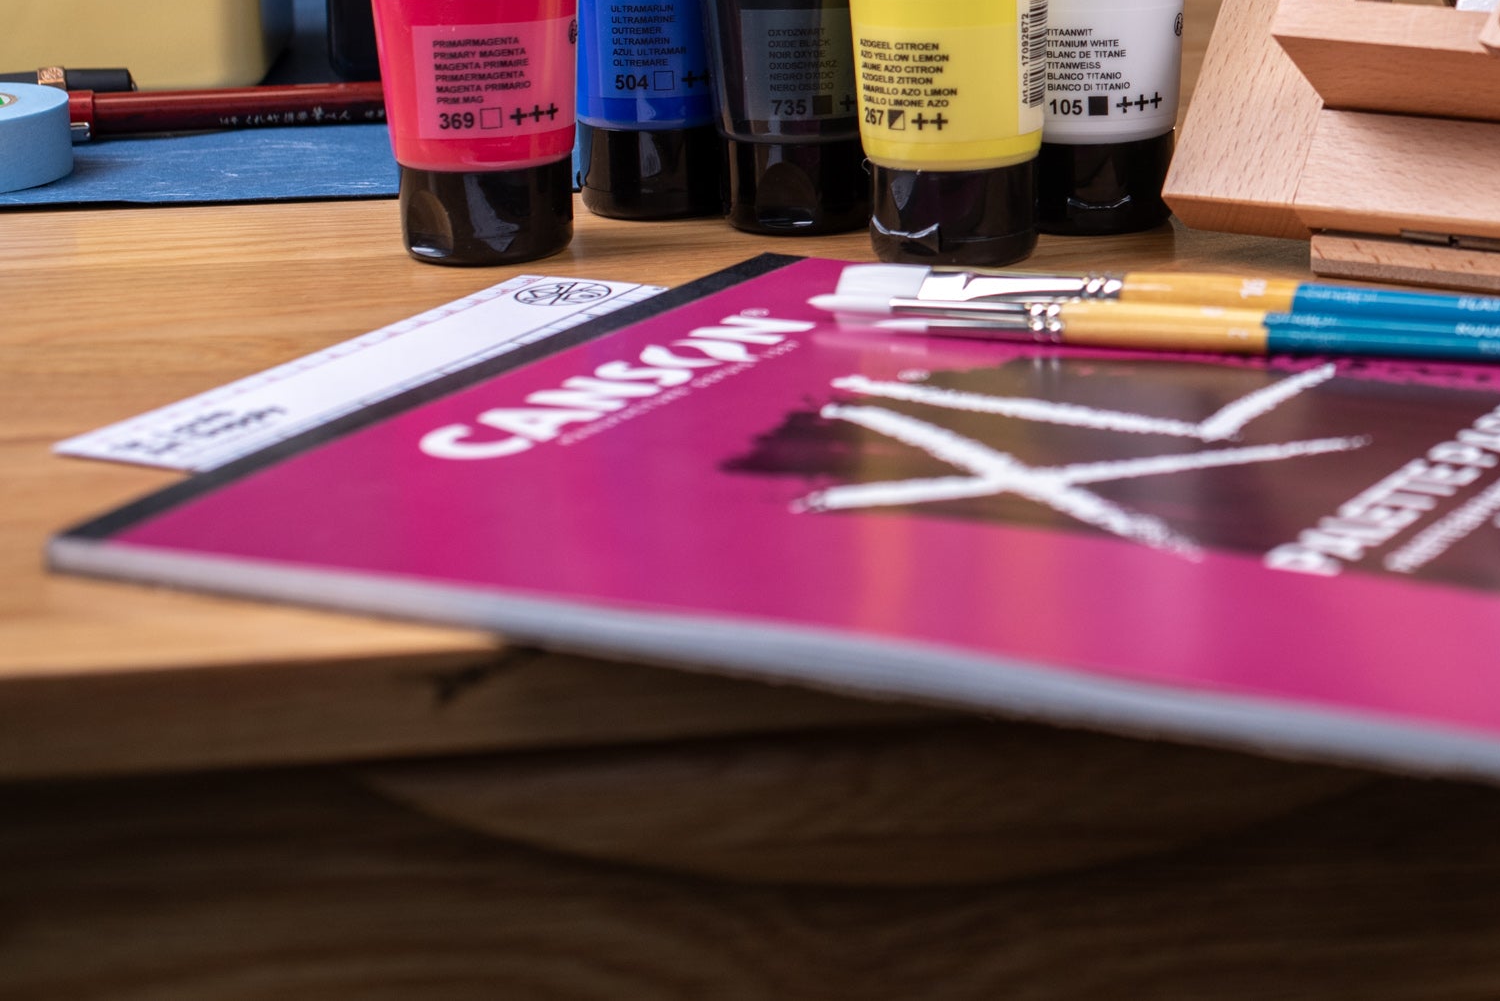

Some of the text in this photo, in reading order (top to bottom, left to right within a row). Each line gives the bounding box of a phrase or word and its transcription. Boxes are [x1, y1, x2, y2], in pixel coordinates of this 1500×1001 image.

[611, 15, 677, 24] ULTRAMARINE
[1046, 29, 1093, 37] TITAANWIT
[433, 37, 519, 48] PRIMAIRMAGENTA
[768, 39, 831, 48] OXIDE BLACK
[860, 38, 939, 51] AZOGEEL CITROEN
[1046, 39, 1119, 48] TITANIUM WHITE
[434, 48, 526, 60] PRIMARY MAGENTA
[613, 46, 686, 56] AZUL ULTRAMAR
[769, 51, 791, 59] NOIR
[861, 50, 949, 62] AZO YELLOW LEMON
[1047, 50, 1126, 59] BLANC DE TITANE
[434, 58, 529, 71] MAGENTA PRIMAIRE
[613, 59, 668, 67] OLTREMARE
[862, 62, 943, 74] JAUNE AZO CITRON
[1047, 62, 1101, 70] TITANWEISS
[435, 71, 524, 82] PRIMAERMAGENTA
[615, 74, 649, 90] 504
[770, 73, 802, 81] NEGRO
[862, 73, 933, 85] AZOGELB ZITRON
[1047, 72, 1122, 81] BLANCO TITANIO
[436, 81, 531, 93] MAGENTA PRIMARIO
[770, 84, 796, 92] NERO
[863, 84, 958, 96] AMARILLO AZO LIMON
[1047, 82, 1130, 91] BIANCO DI TITANIO
[863, 95, 949, 107] GIALLO LIMONE AZO
[1049, 99, 1083, 115] 105
[772, 100, 806, 116] 735
[439, 112, 475, 130] 369
[864, 107, 884, 126] 267
[1457, 295, 1500, 312] FLAT
[419, 315, 816, 460] CANSON
[1263, 458, 1483, 577] PALETTE
